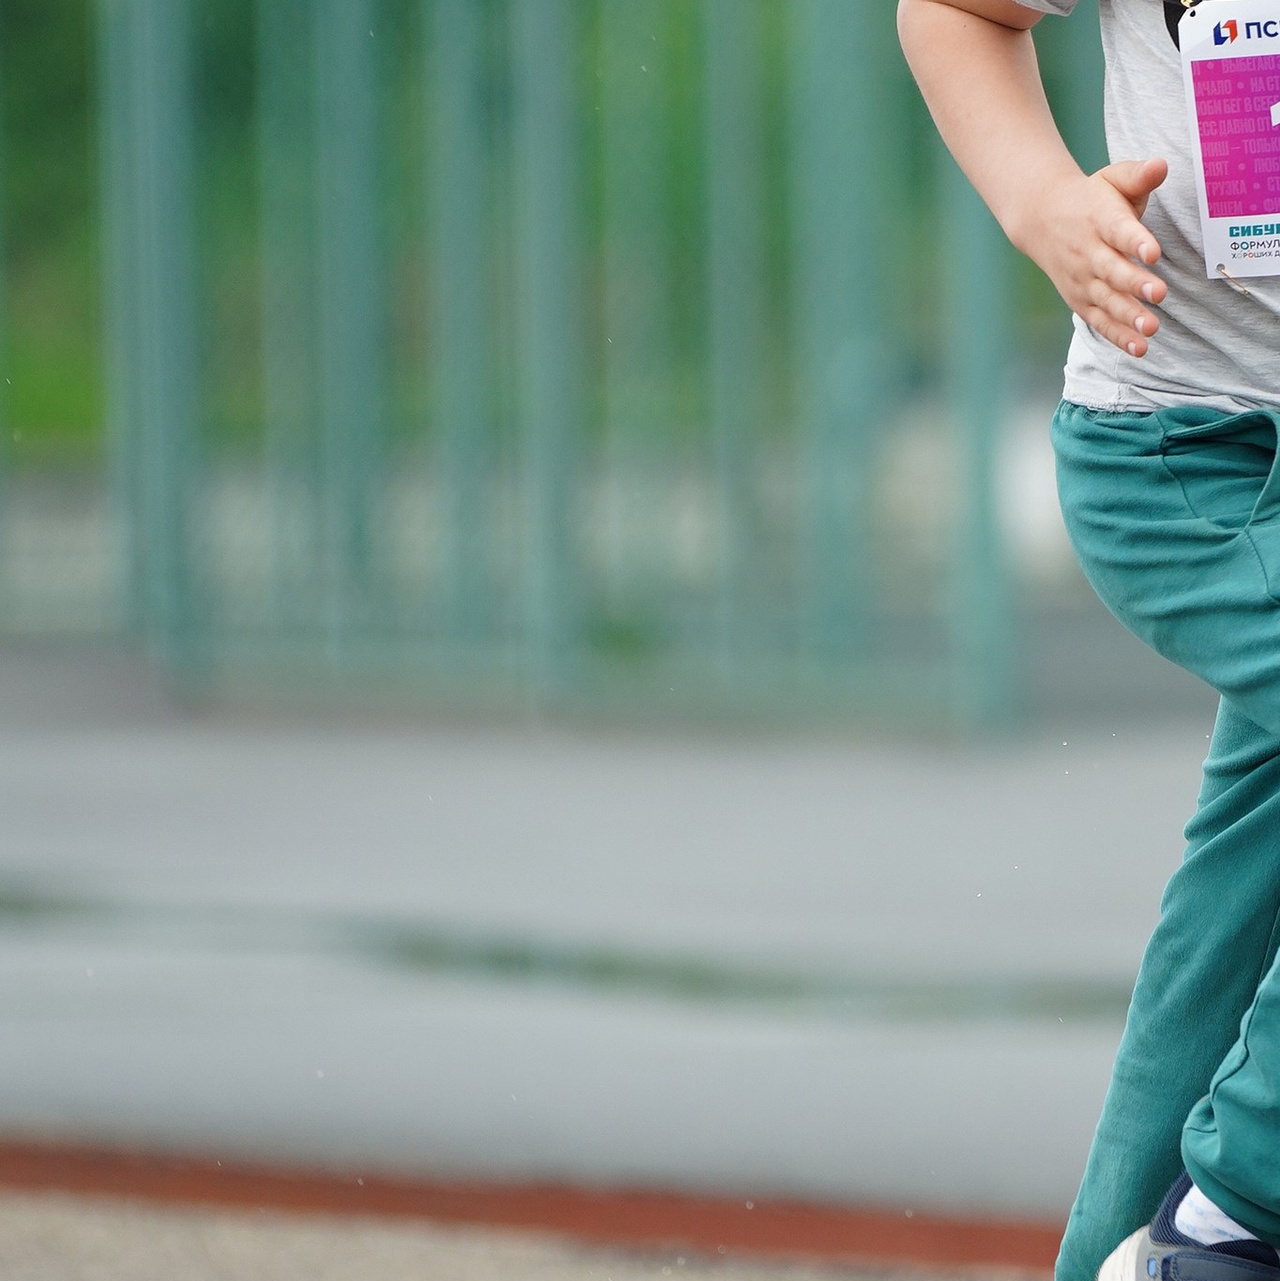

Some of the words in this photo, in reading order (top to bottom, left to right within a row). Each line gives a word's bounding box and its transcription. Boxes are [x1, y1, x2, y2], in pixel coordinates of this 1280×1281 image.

[1250, 77, 1266, 93] НА
[1223, 98, 1242, 115] БЕГ
[1244, 97, 1252, 113] В
[1218, 118, 1255, 138] ДАВНО
[1231, 250, 1273, 259] ХОРОШИХ
